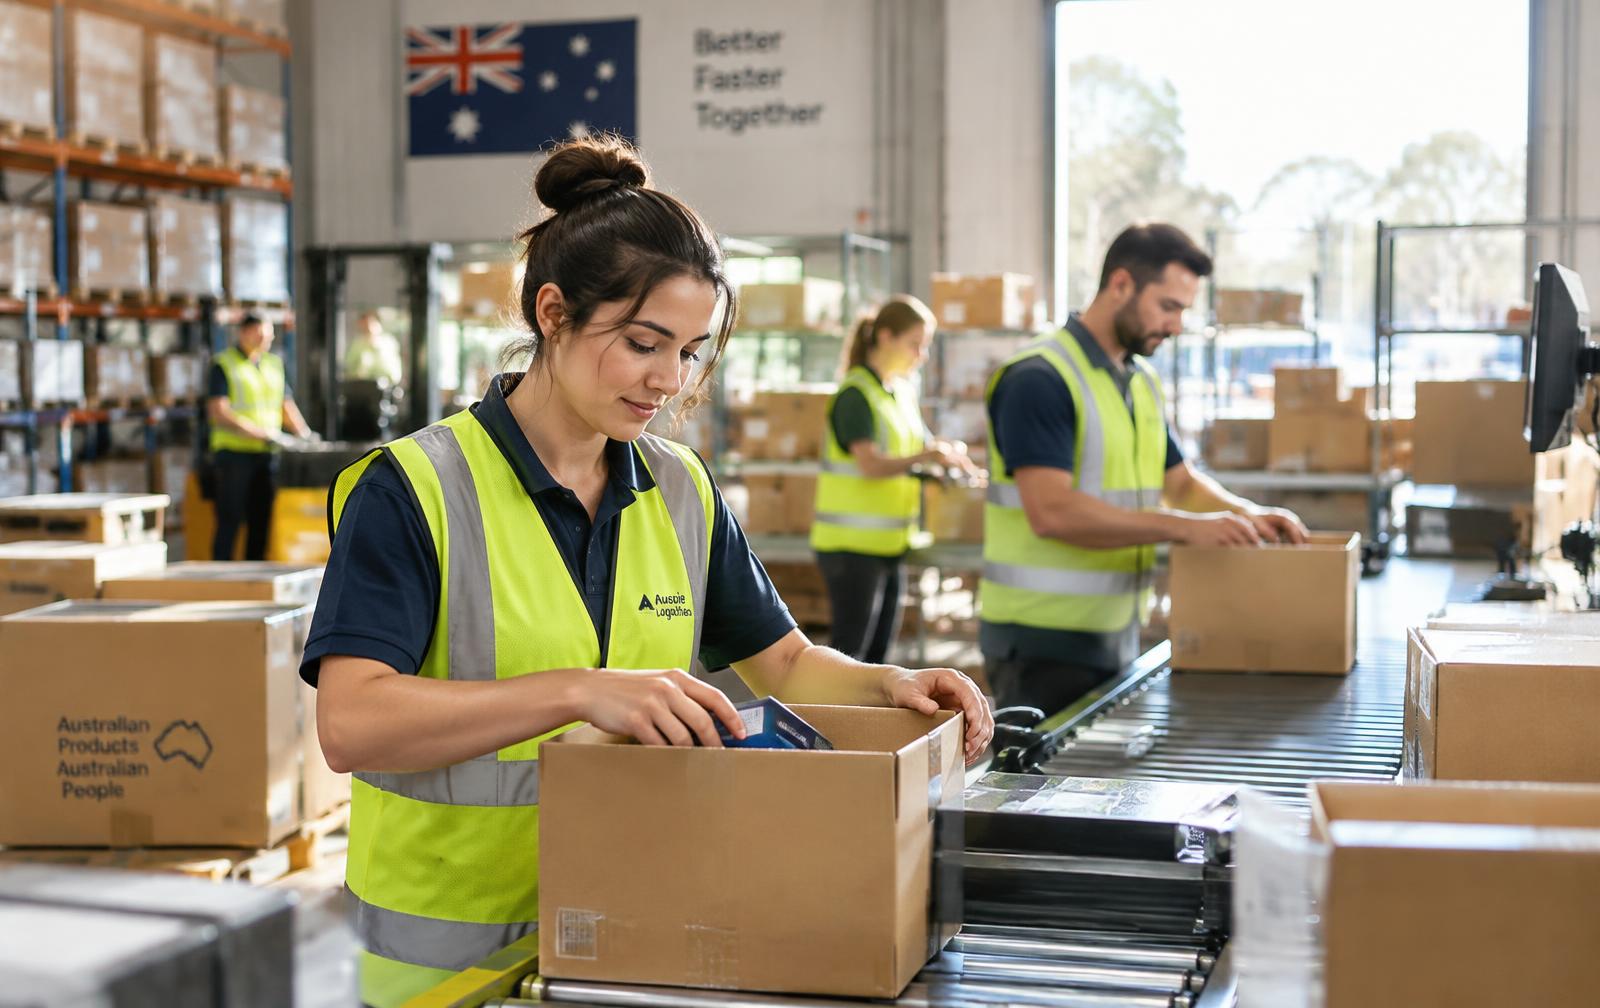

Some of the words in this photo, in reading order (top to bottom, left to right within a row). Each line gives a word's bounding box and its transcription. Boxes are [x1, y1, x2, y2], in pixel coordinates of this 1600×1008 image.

[694, 29, 783, 54] Better
[694, 66, 783, 91] Faster
[695, 102, 823, 133] Together
[57, 716, 150, 733] Australian
[58, 738, 139, 754] Products
[57, 760, 149, 776] Australian
[61, 781, 124, 801] People
